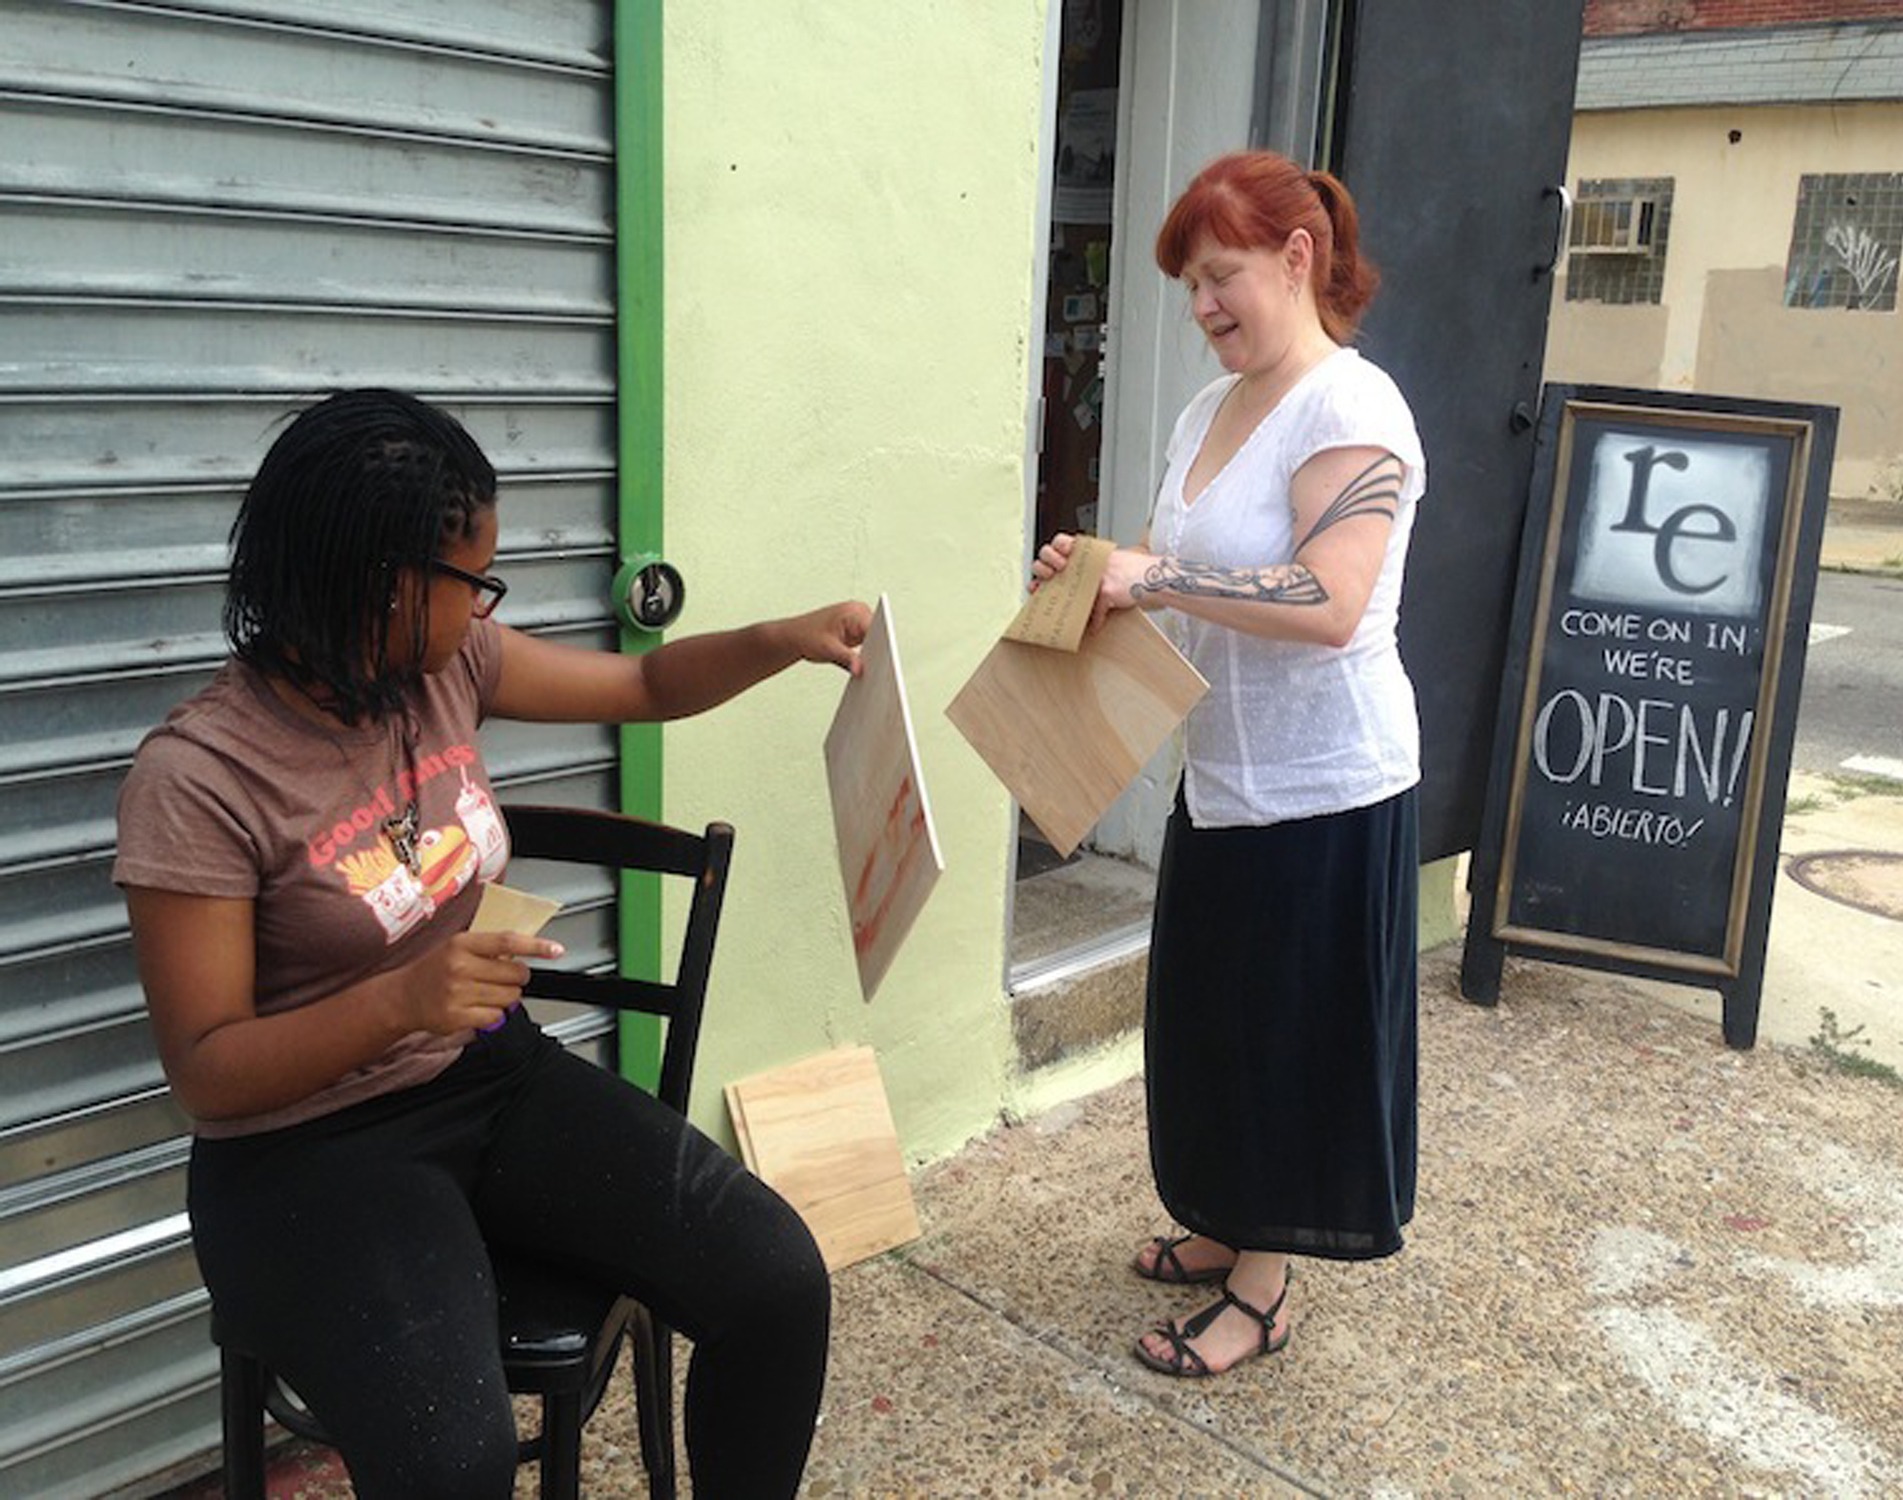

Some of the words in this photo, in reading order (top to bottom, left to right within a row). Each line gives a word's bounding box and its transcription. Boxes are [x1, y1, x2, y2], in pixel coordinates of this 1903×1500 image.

[1610, 444, 1736, 595] re
[1561, 609, 1641, 640] COME
[1648, 620, 1691, 643] ON
[1707, 622, 1747, 655] IN
[1604, 650, 1694, 686] WE'RE
[308, 785, 396, 867] Good
[398, 745, 476, 801] Tmes
[1533, 689, 1755, 807] OPEN!
